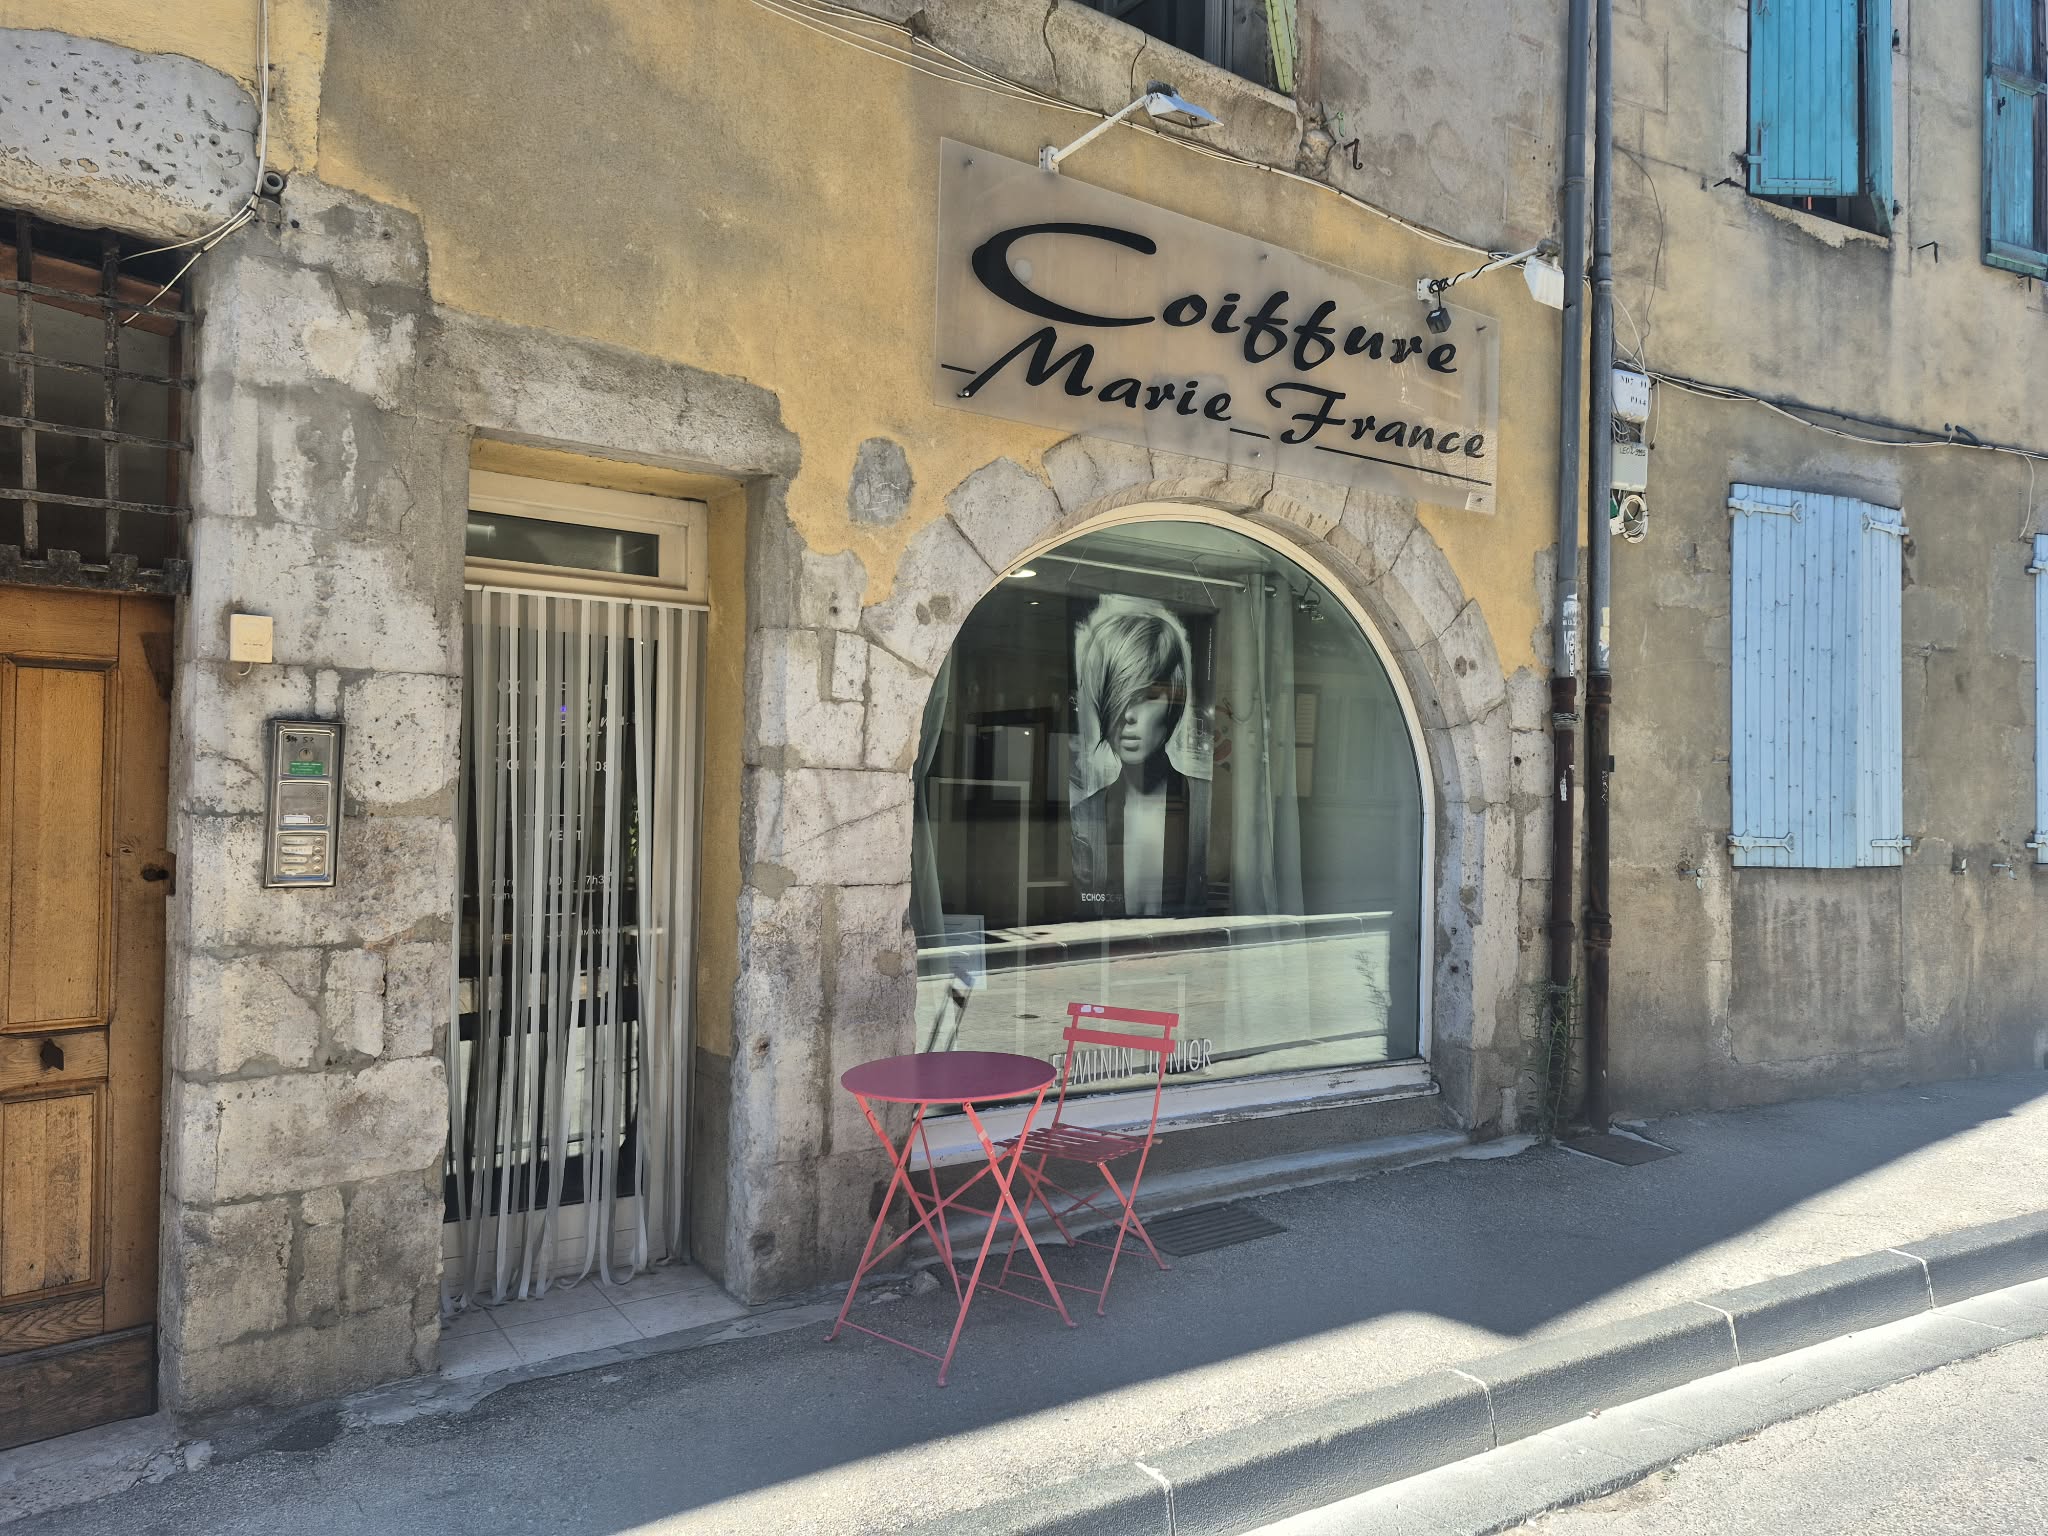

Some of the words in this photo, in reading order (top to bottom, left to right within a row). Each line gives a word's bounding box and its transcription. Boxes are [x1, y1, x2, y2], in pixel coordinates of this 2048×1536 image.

[971, 222, 1458, 374] Coiffure
[957, 326, 1232, 422] Marie
[1266, 381, 1485, 459] France
